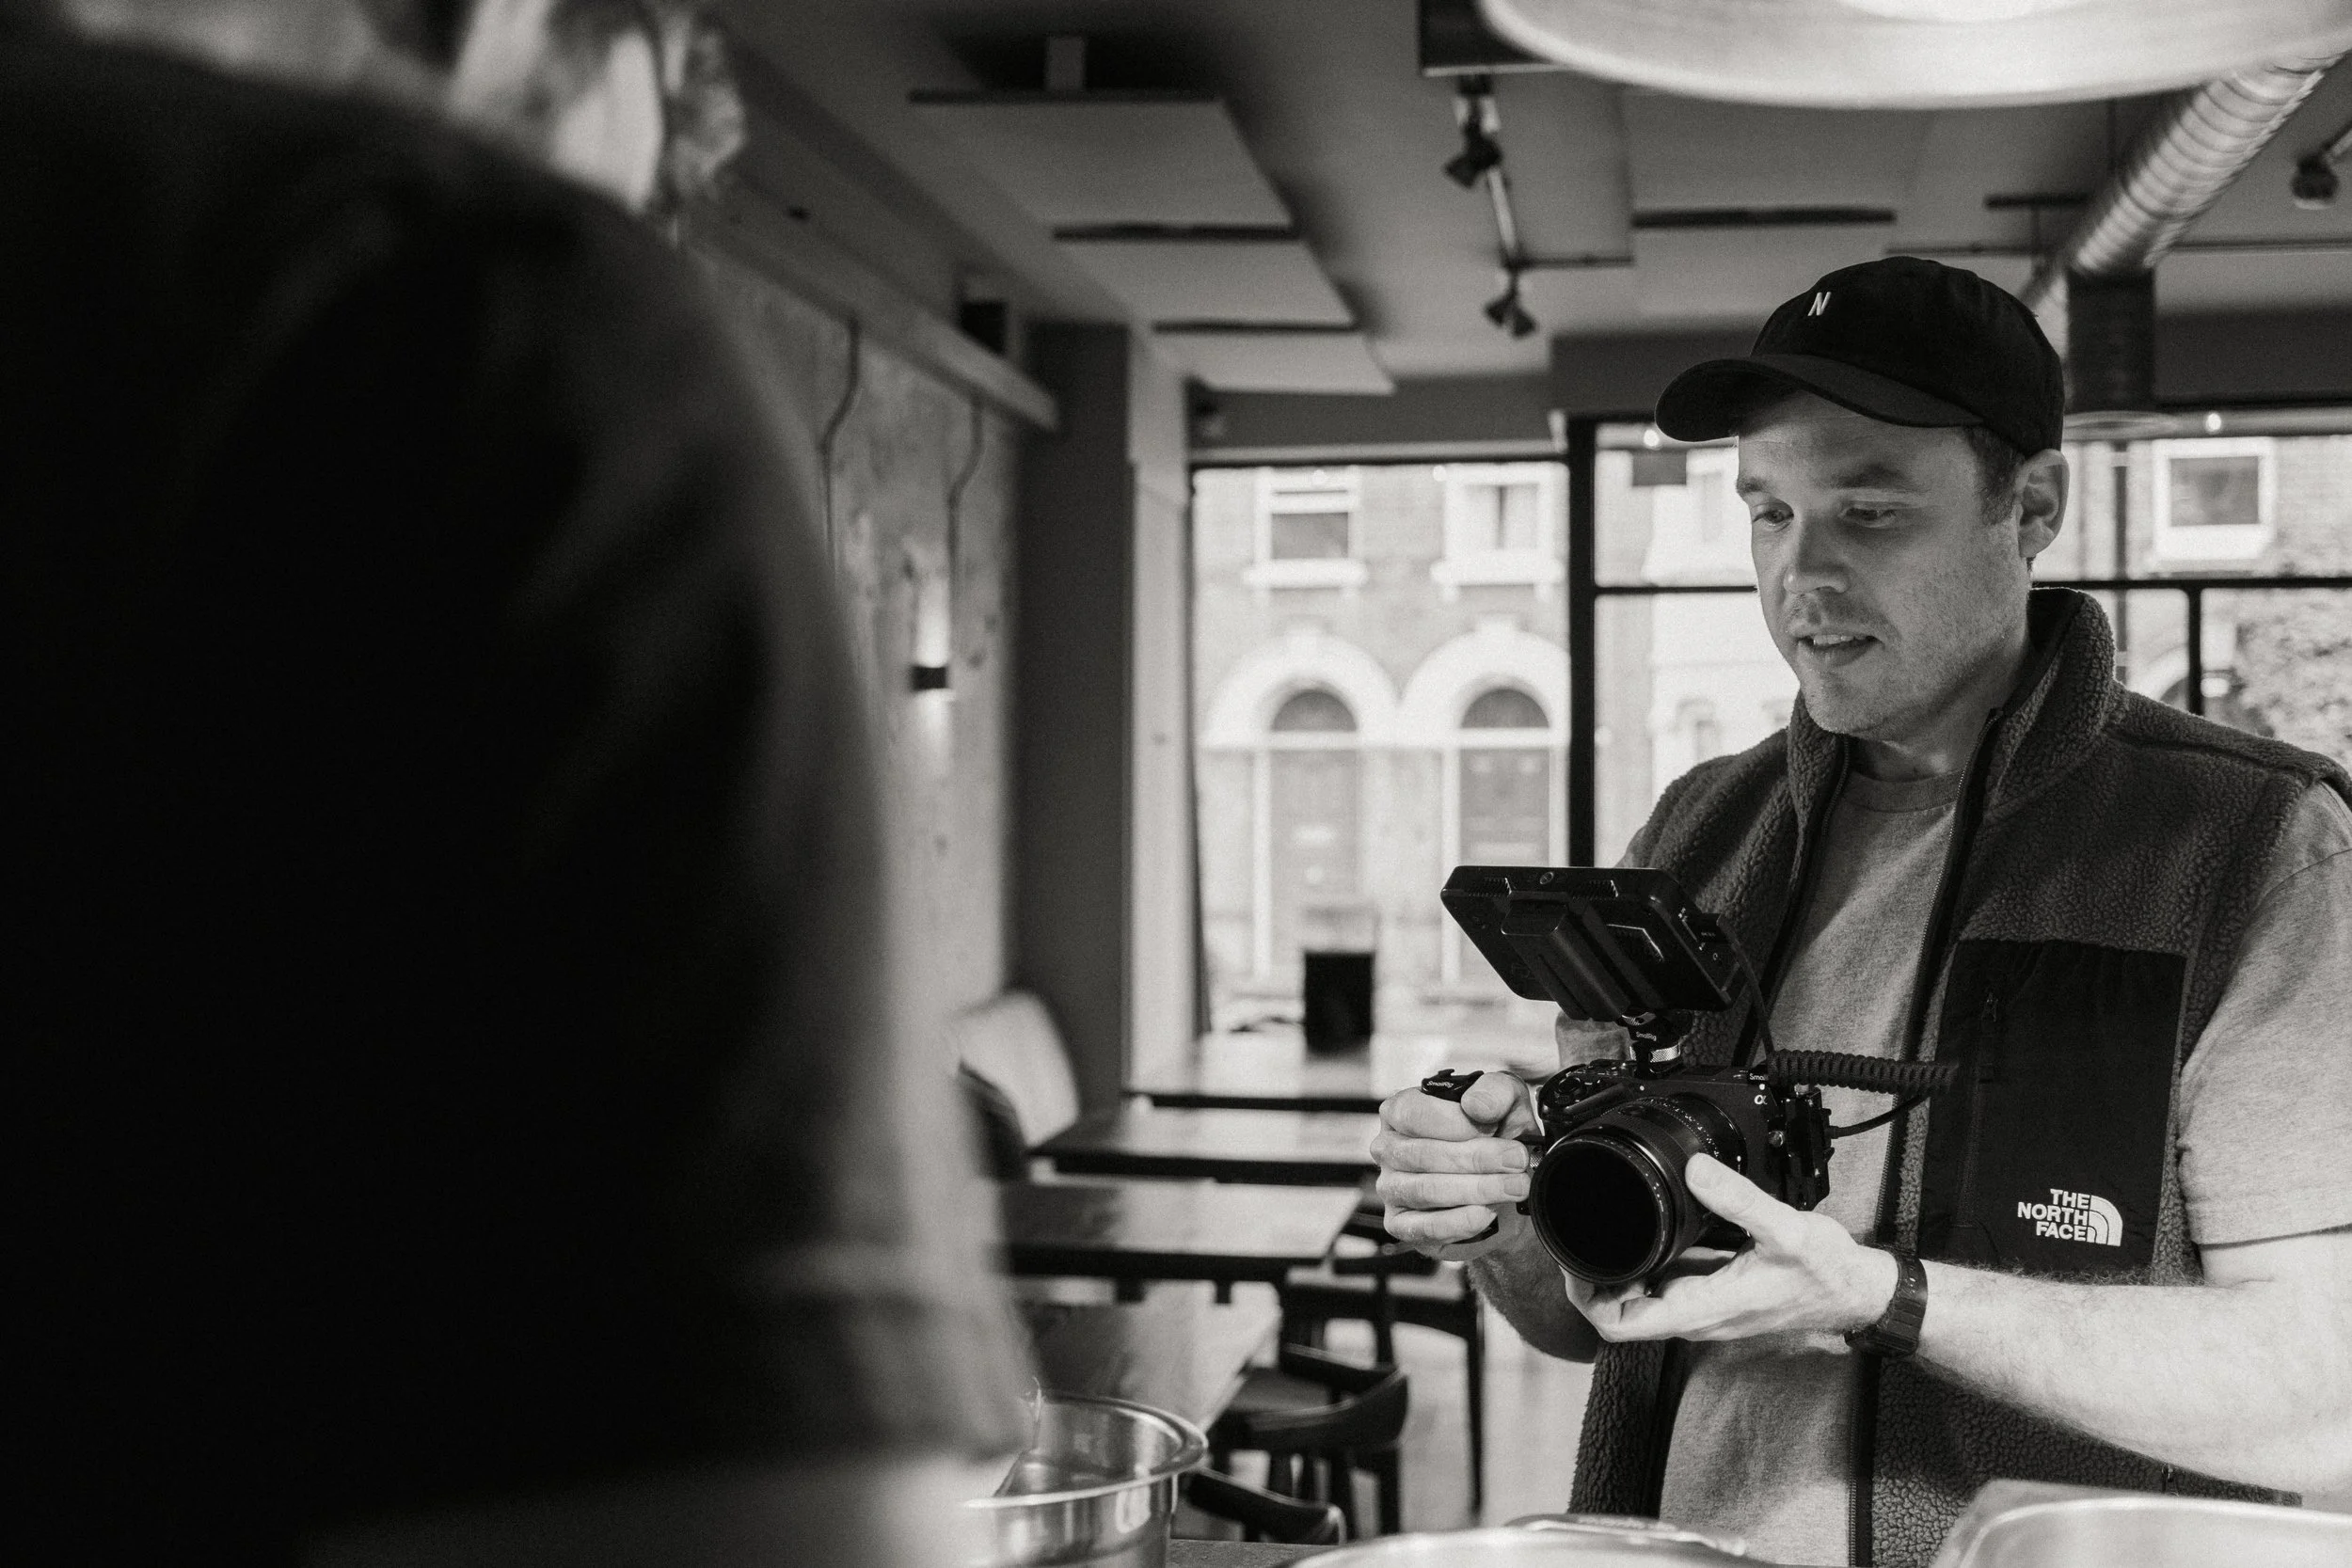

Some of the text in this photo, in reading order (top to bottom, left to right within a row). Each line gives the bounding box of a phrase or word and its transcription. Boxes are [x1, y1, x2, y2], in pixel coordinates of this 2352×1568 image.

[1807, 292, 1832, 316] N
[2050, 1188, 2090, 1211] THE
[2017, 1201, 2089, 1227] NORTH
[2036, 1221, 2088, 1242] FACE
